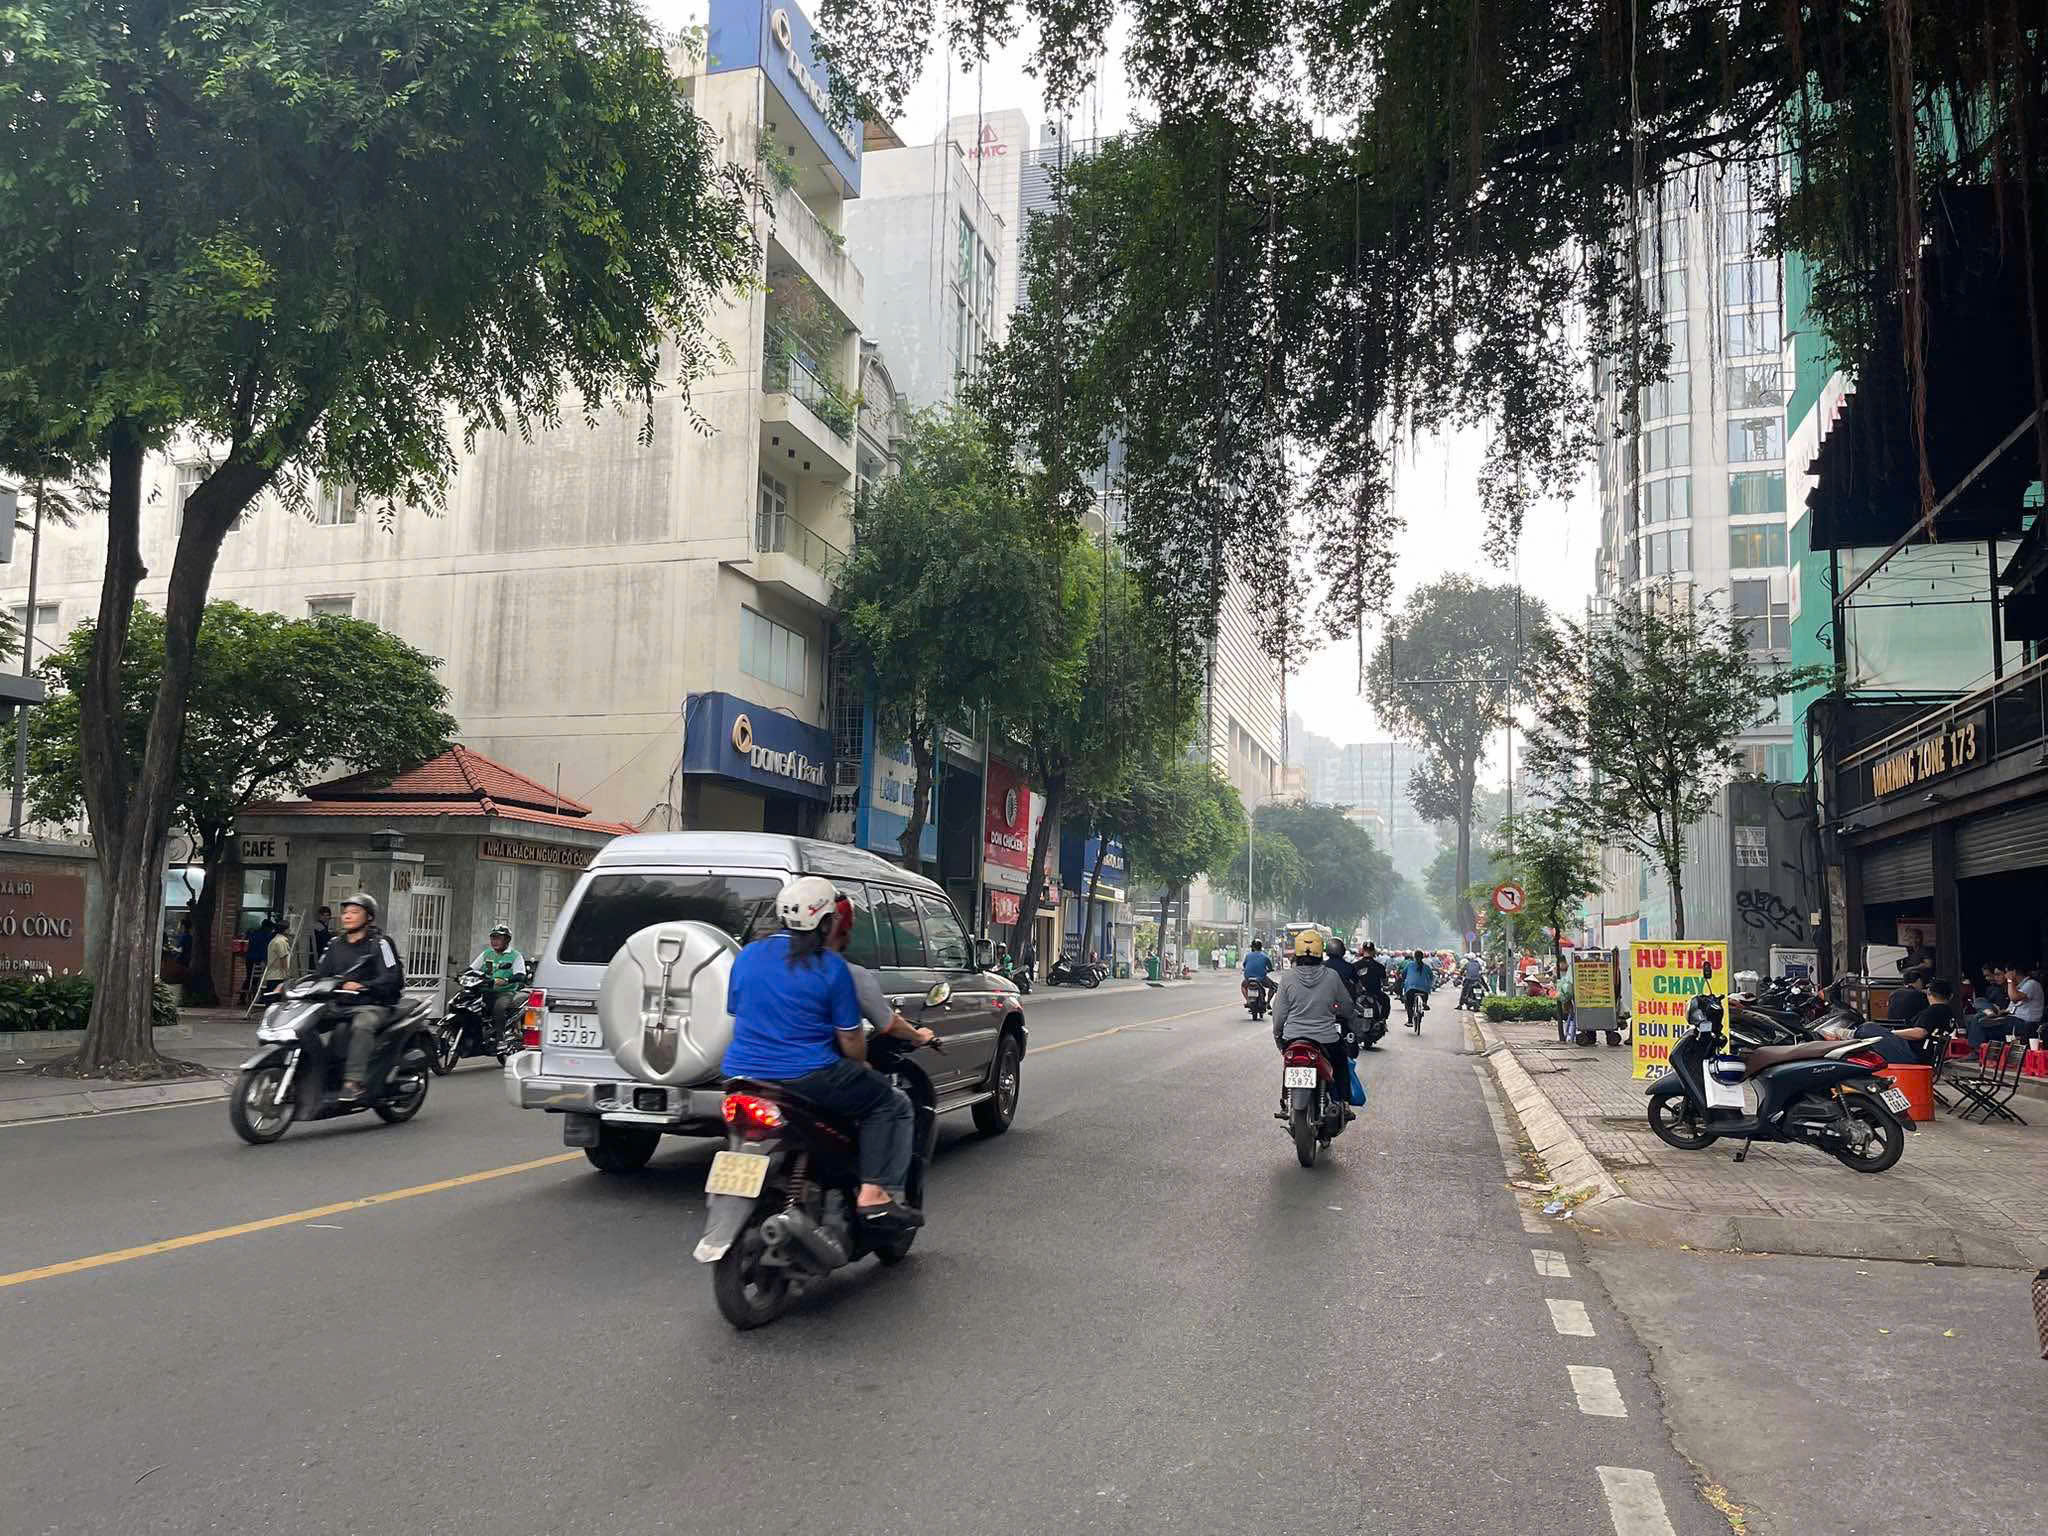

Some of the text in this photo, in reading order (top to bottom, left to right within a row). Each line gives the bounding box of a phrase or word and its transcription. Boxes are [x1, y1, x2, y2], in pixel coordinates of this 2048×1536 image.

[1872, 723, 1976, 797] WARNING ZONE 173
[0, 909, 73, 938] Ó CÔNG
[1653, 974, 1706, 995] CHAY
[1638, 998, 1668, 1016] BÚN
[563, 1014, 587, 1029] 51L
[1639, 1020, 1668, 1037] BÚN
[1639, 1041, 1668, 1060] BÚN
